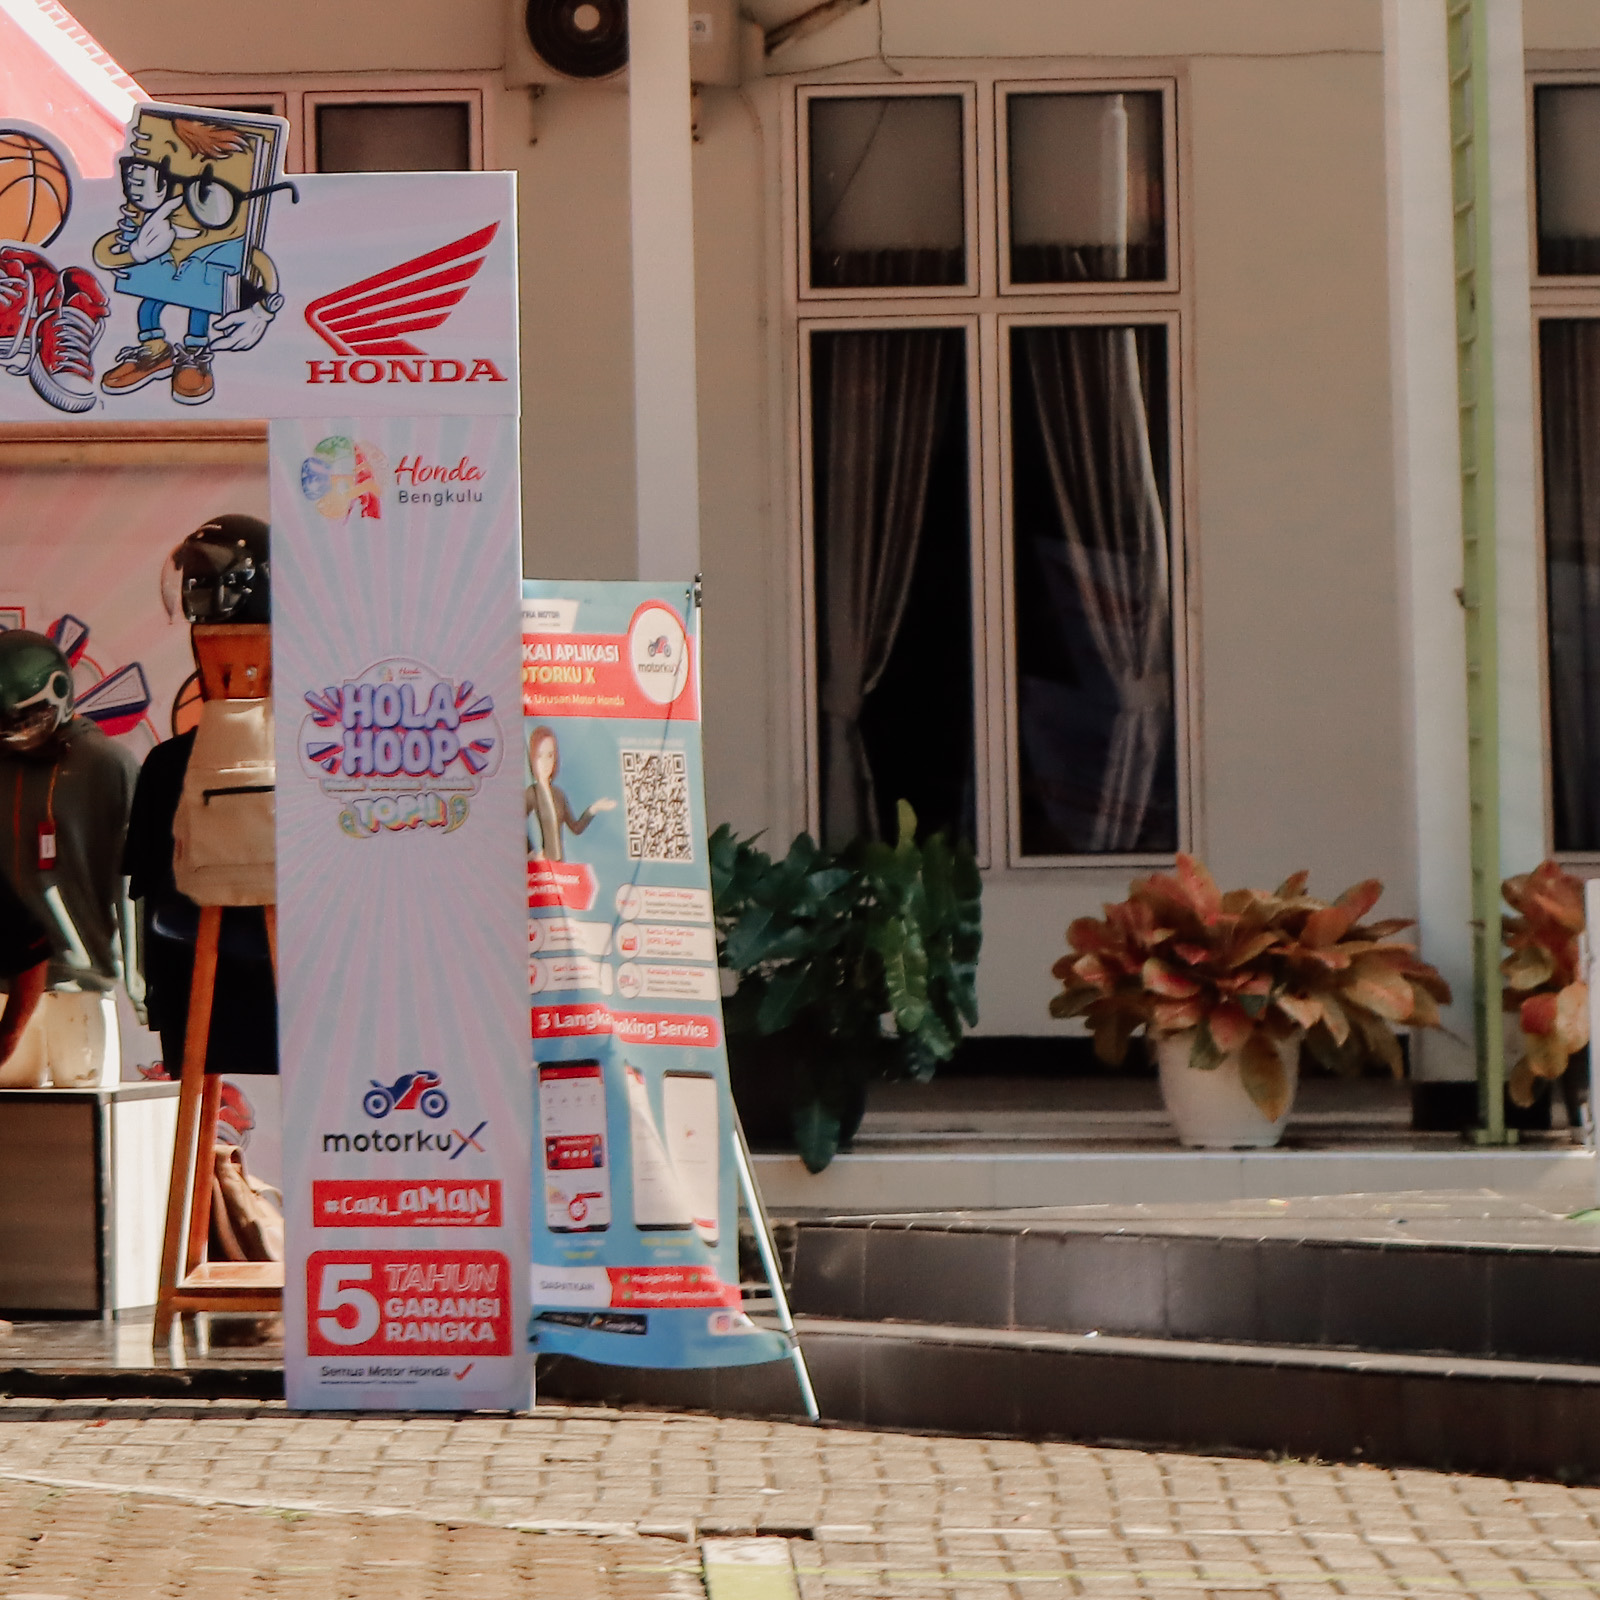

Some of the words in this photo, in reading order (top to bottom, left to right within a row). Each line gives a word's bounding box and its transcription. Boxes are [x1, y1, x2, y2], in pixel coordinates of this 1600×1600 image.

[306, 358, 508, 384] HONDA
[395, 455, 486, 486] Honda
[398, 489, 483, 506] Bengkulu
[537, 610, 560, 619] MOTOR
[556, 644, 619, 662] APLIKASI
[585, 666, 596, 684] X
[342, 683, 460, 730] HOLA
[342, 729, 460, 778] HOOP
[538, 1013, 551, 1029] 3
[658, 1020, 709, 1038] Service
[323, 1121, 489, 1160] motorkuX
[384, 1263, 499, 1292] TAHUN
[317, 1263, 381, 1346] 5
[385, 1298, 500, 1318] GARANSI
[385, 1322, 497, 1342] RANGKA
[321, 1366, 364, 1377] Semua
[368, 1366, 405, 1377] Motor
[409, 1366, 450, 1377] Honda
